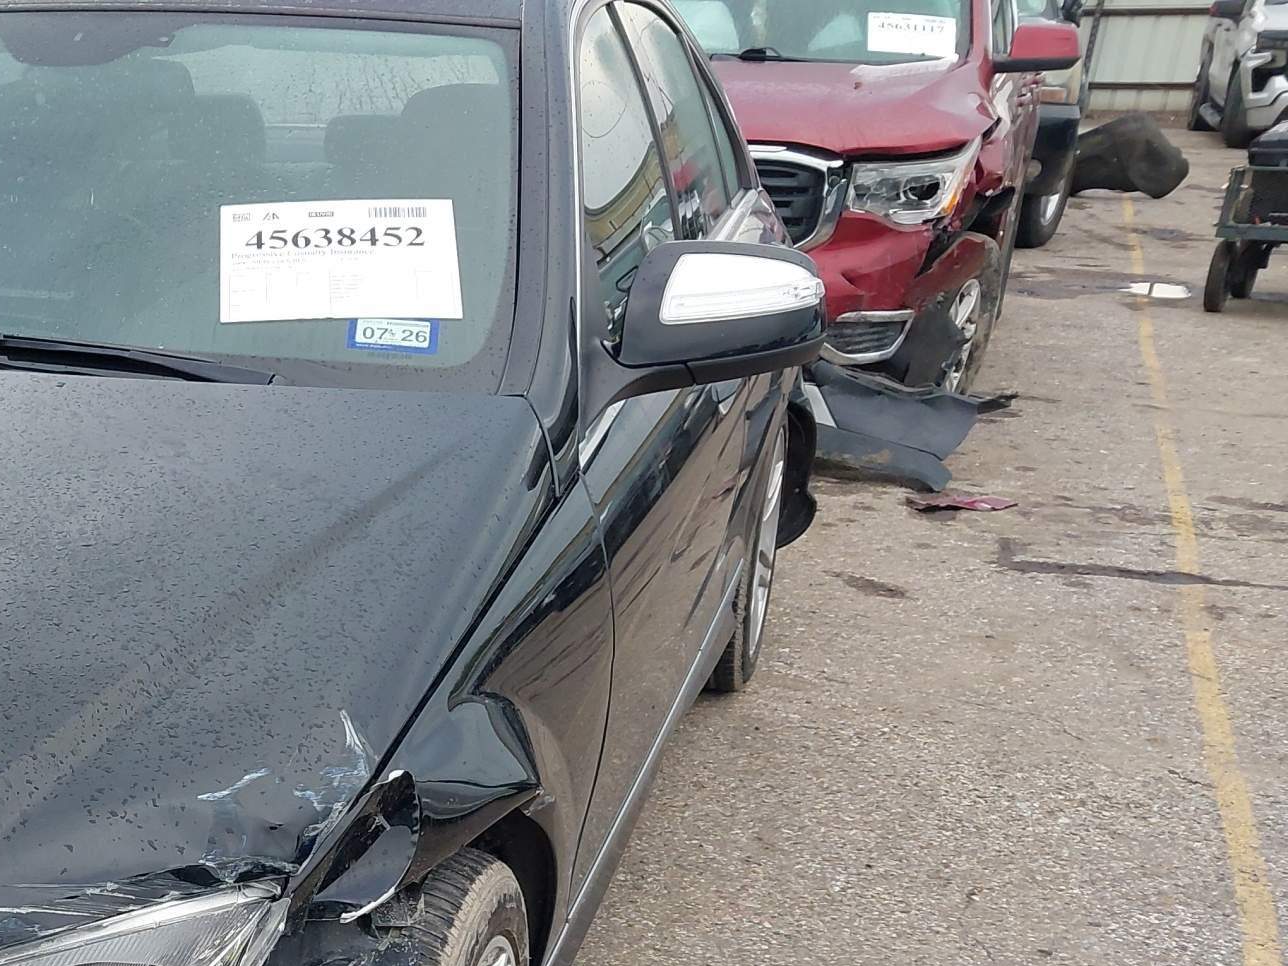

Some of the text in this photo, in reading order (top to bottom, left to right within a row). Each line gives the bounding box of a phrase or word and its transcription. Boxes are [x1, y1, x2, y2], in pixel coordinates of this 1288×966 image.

[245, 226, 425, 250] 45638452
[362, 326, 428, 343] 07 26
